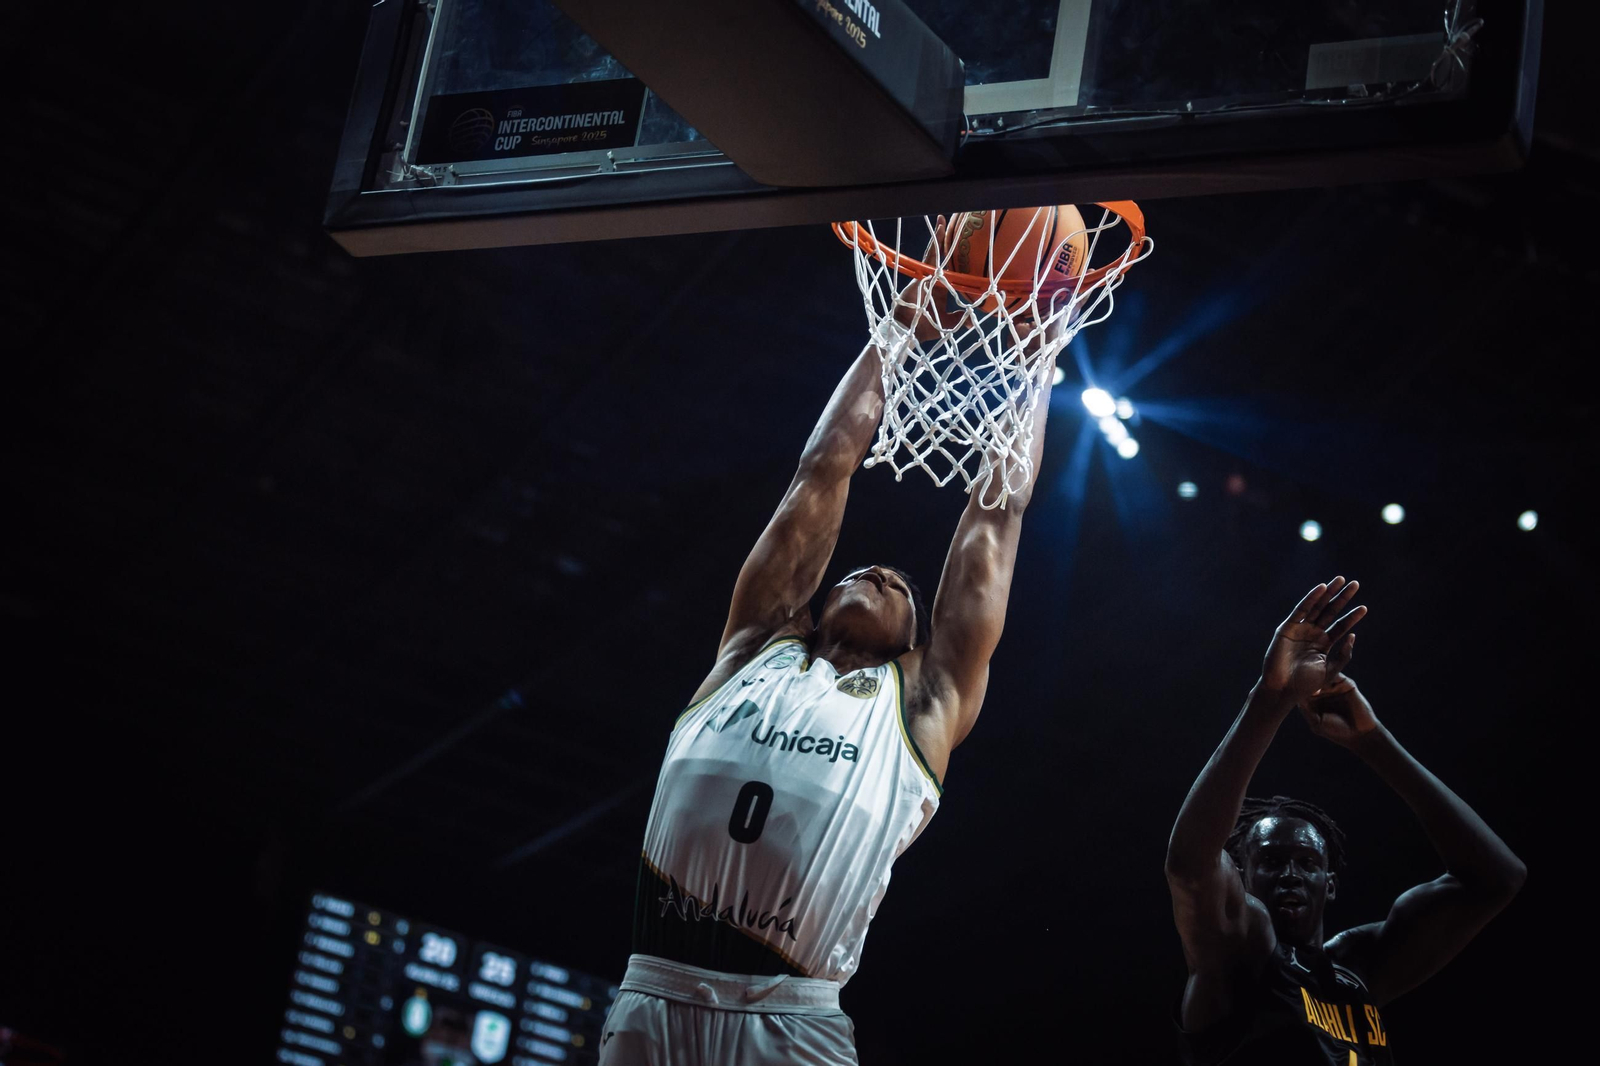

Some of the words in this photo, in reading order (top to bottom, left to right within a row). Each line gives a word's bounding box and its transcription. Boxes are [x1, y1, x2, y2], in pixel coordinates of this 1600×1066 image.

[845, 16, 867, 49] 2025
[497, 110, 626, 135] INTERCONTINENTAL
[507, 109, 523, 118] FIBA
[494, 136, 522, 152] CUP
[531, 133, 579, 148] Singapore
[581, 130, 608, 142] 2025
[1054, 243, 1073, 273] FIBA
[750, 719, 860, 763] Unicaja
[728, 781, 774, 844] 0
[658, 874, 797, 941] Andalucía
[1363, 1003, 1388, 1047] SC
